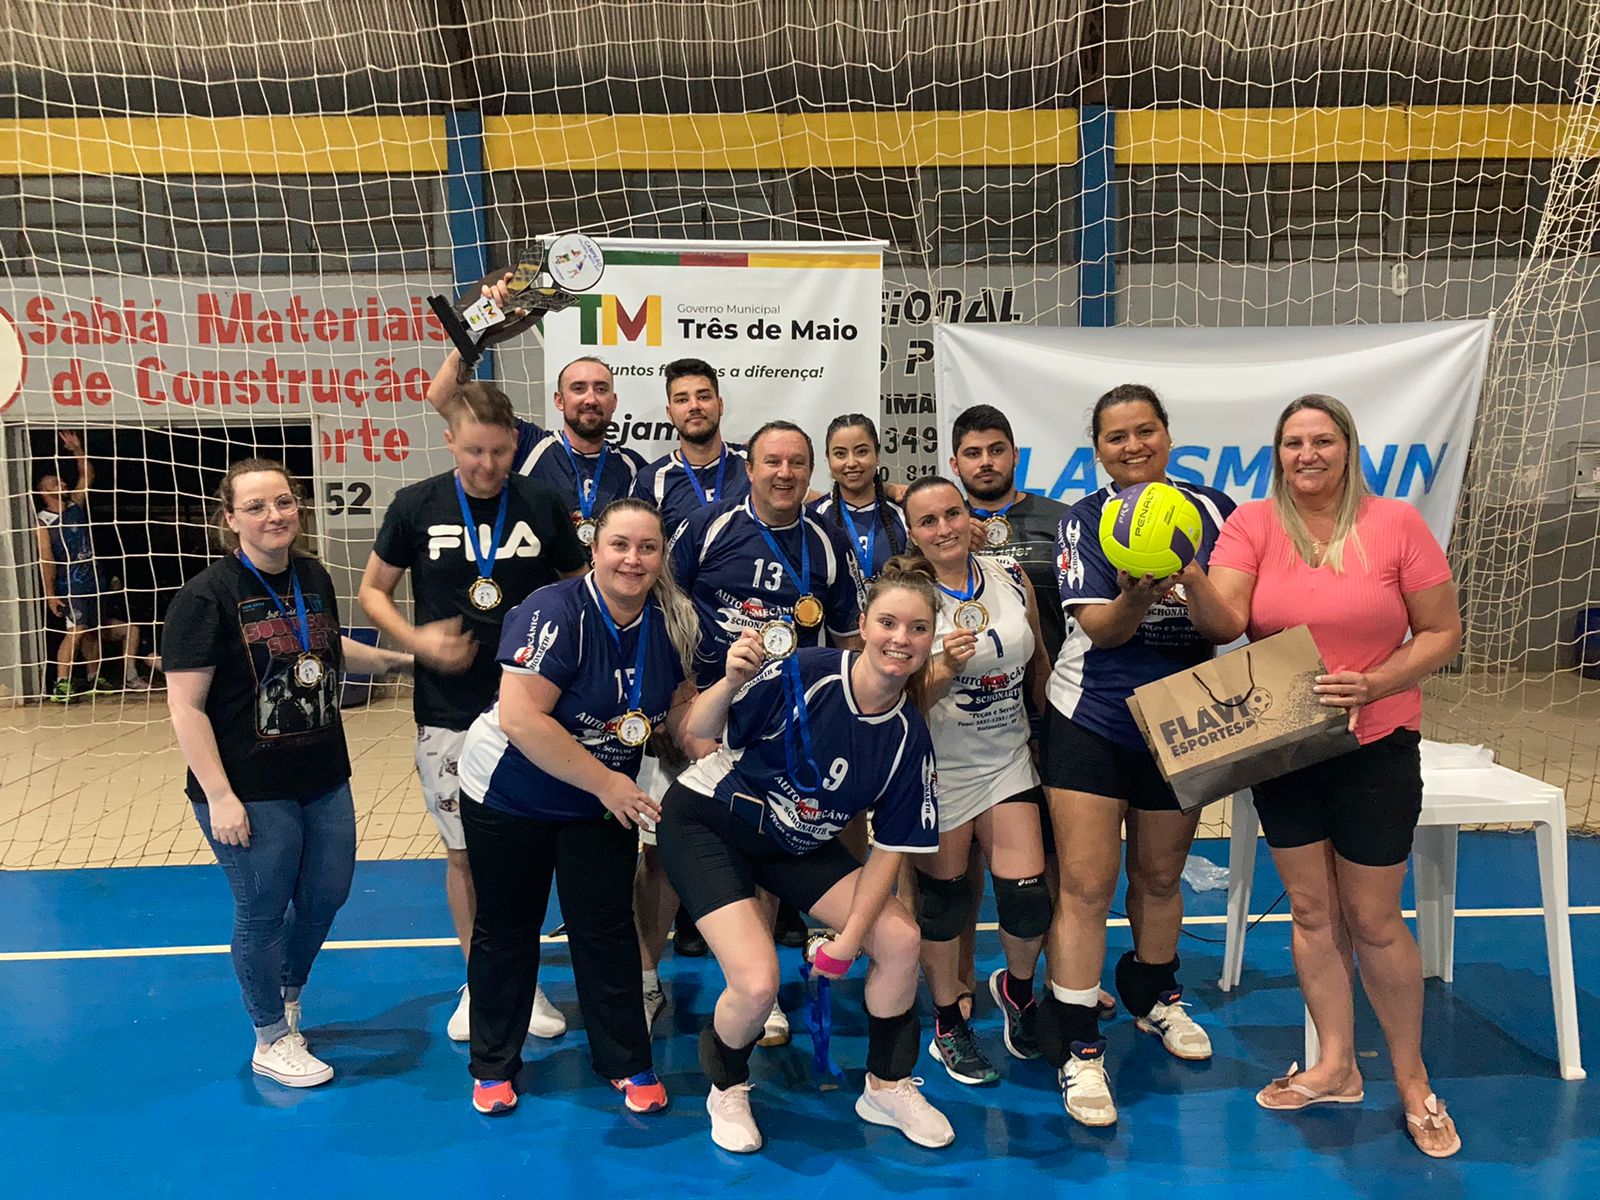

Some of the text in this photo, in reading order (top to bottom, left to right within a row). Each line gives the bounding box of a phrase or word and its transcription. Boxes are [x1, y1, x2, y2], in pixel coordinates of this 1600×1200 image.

[26, 293, 450, 345] Sabiá Materiais
[570, 294, 662, 347] TM
[677, 303, 781, 316] Governo Municipal
[677, 317, 858, 341] Três de Maio
[53, 356, 433, 408] de Construção
[606, 364, 655, 377] untos
[730, 367, 740, 378] a
[744, 365, 824, 381] diferença!
[605, 413, 680, 446] ejam
[326, 482, 372, 515] 52
[1134, 486, 1156, 537] PENALTY
[427, 520, 542, 562] FILA
[752, 558, 784, 592] 13
[714, 588, 743, 610] AUTO
[986, 628, 1004, 659] 1
[575, 711, 606, 730] AUTO
[1170, 721, 1246, 757] ESPORTES
[774, 776, 801, 803] AUTO
[822, 757, 849, 792] 9
[783, 806, 828, 836] SCHONARTH
